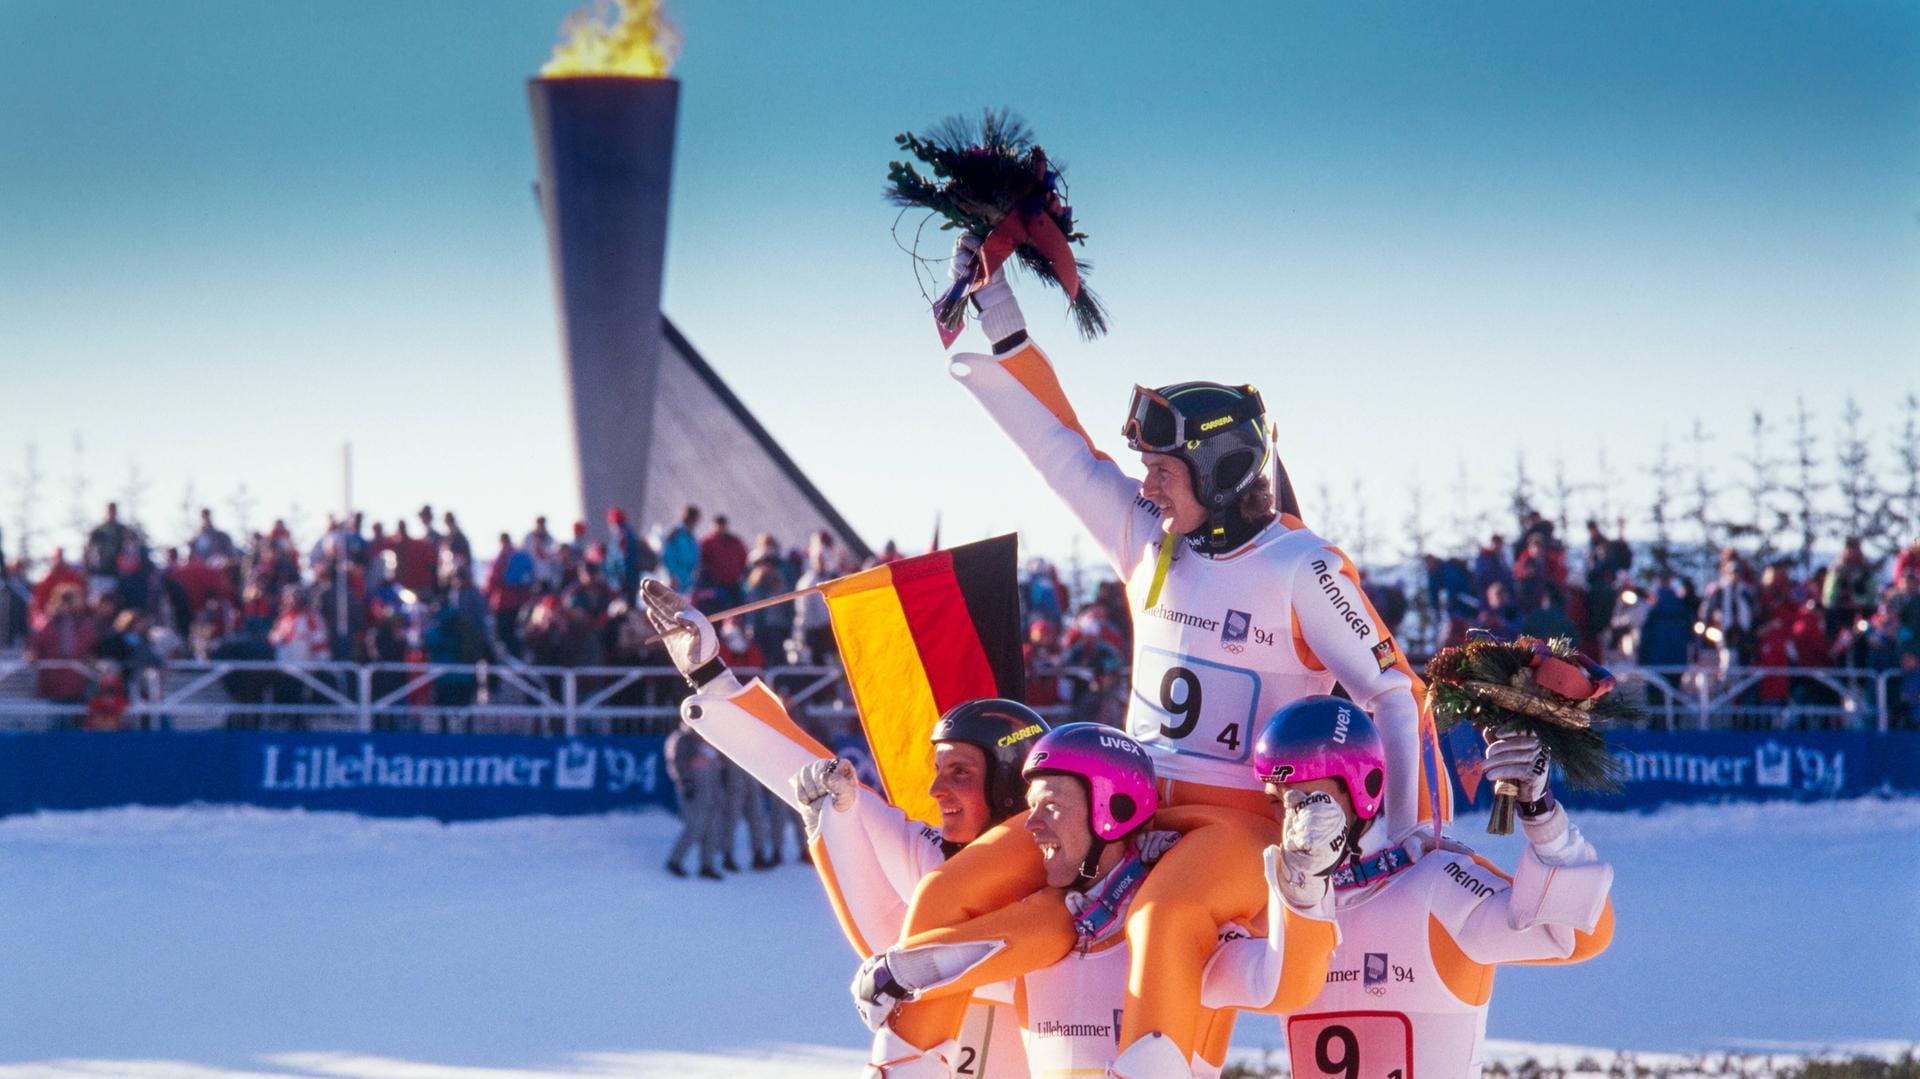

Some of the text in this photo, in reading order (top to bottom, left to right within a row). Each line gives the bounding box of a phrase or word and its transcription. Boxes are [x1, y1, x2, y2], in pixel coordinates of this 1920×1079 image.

[1200, 415, 1234, 431] CARRERA
[1310, 559, 1371, 640] MEININGER
[1253, 626, 1275, 646] '94
[1159, 666, 1202, 740] 9
[997, 724, 1043, 748] CARRERA
[1216, 722, 1240, 751] 4
[1332, 706, 1352, 744] uvex
[1100, 735, 1141, 756] uvex
[262, 742, 658, 793] Lillehammer '94
[1795, 746, 1845, 790] '94
[1111, 874, 1134, 900] uvex
[1443, 861, 1495, 898] MEININ
[1392, 965, 1415, 983] '94
[956, 1047, 977, 1074] 2
[1315, 1024, 1360, 1079] 9
